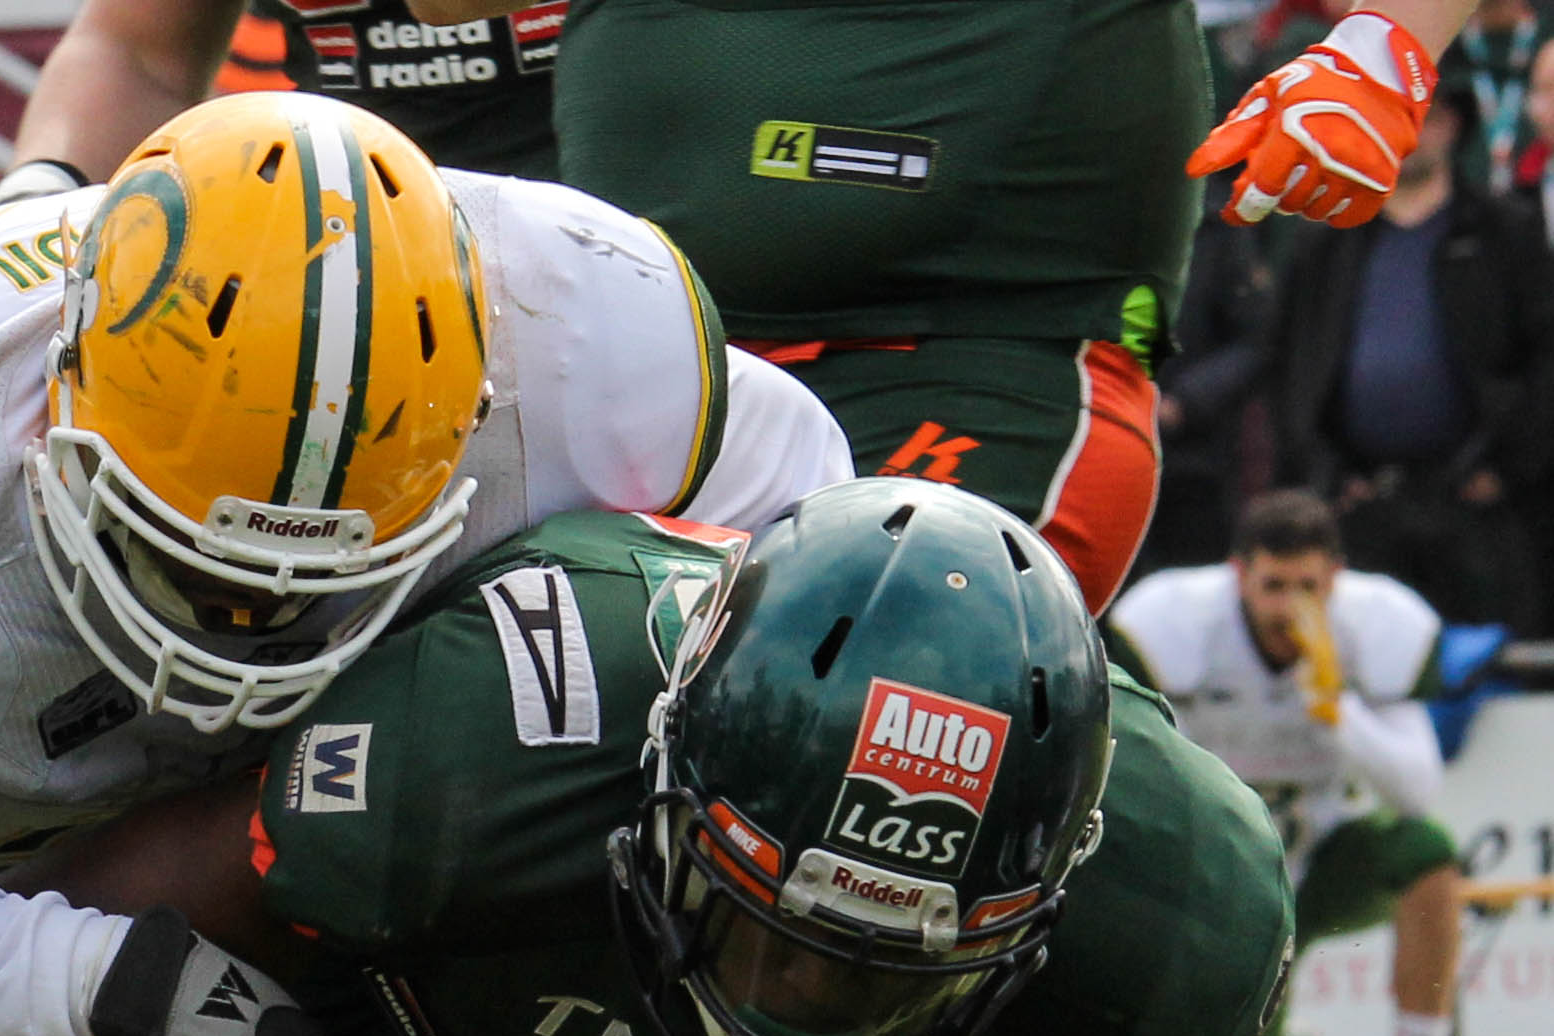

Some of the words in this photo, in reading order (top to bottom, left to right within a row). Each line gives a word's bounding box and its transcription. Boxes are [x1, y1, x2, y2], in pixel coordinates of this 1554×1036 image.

[366, 19, 493, 49] delta
[369, 54, 498, 88] radio
[766, 129, 806, 162] K
[247, 511, 339, 538] Riddell
[869, 692, 993, 773] Auto
[312, 733, 361, 801] W
[864, 748, 980, 791] centrum
[727, 822, 761, 857] NIKE
[839, 803, 966, 864] Lass
[831, 865, 923, 908] Riddell
